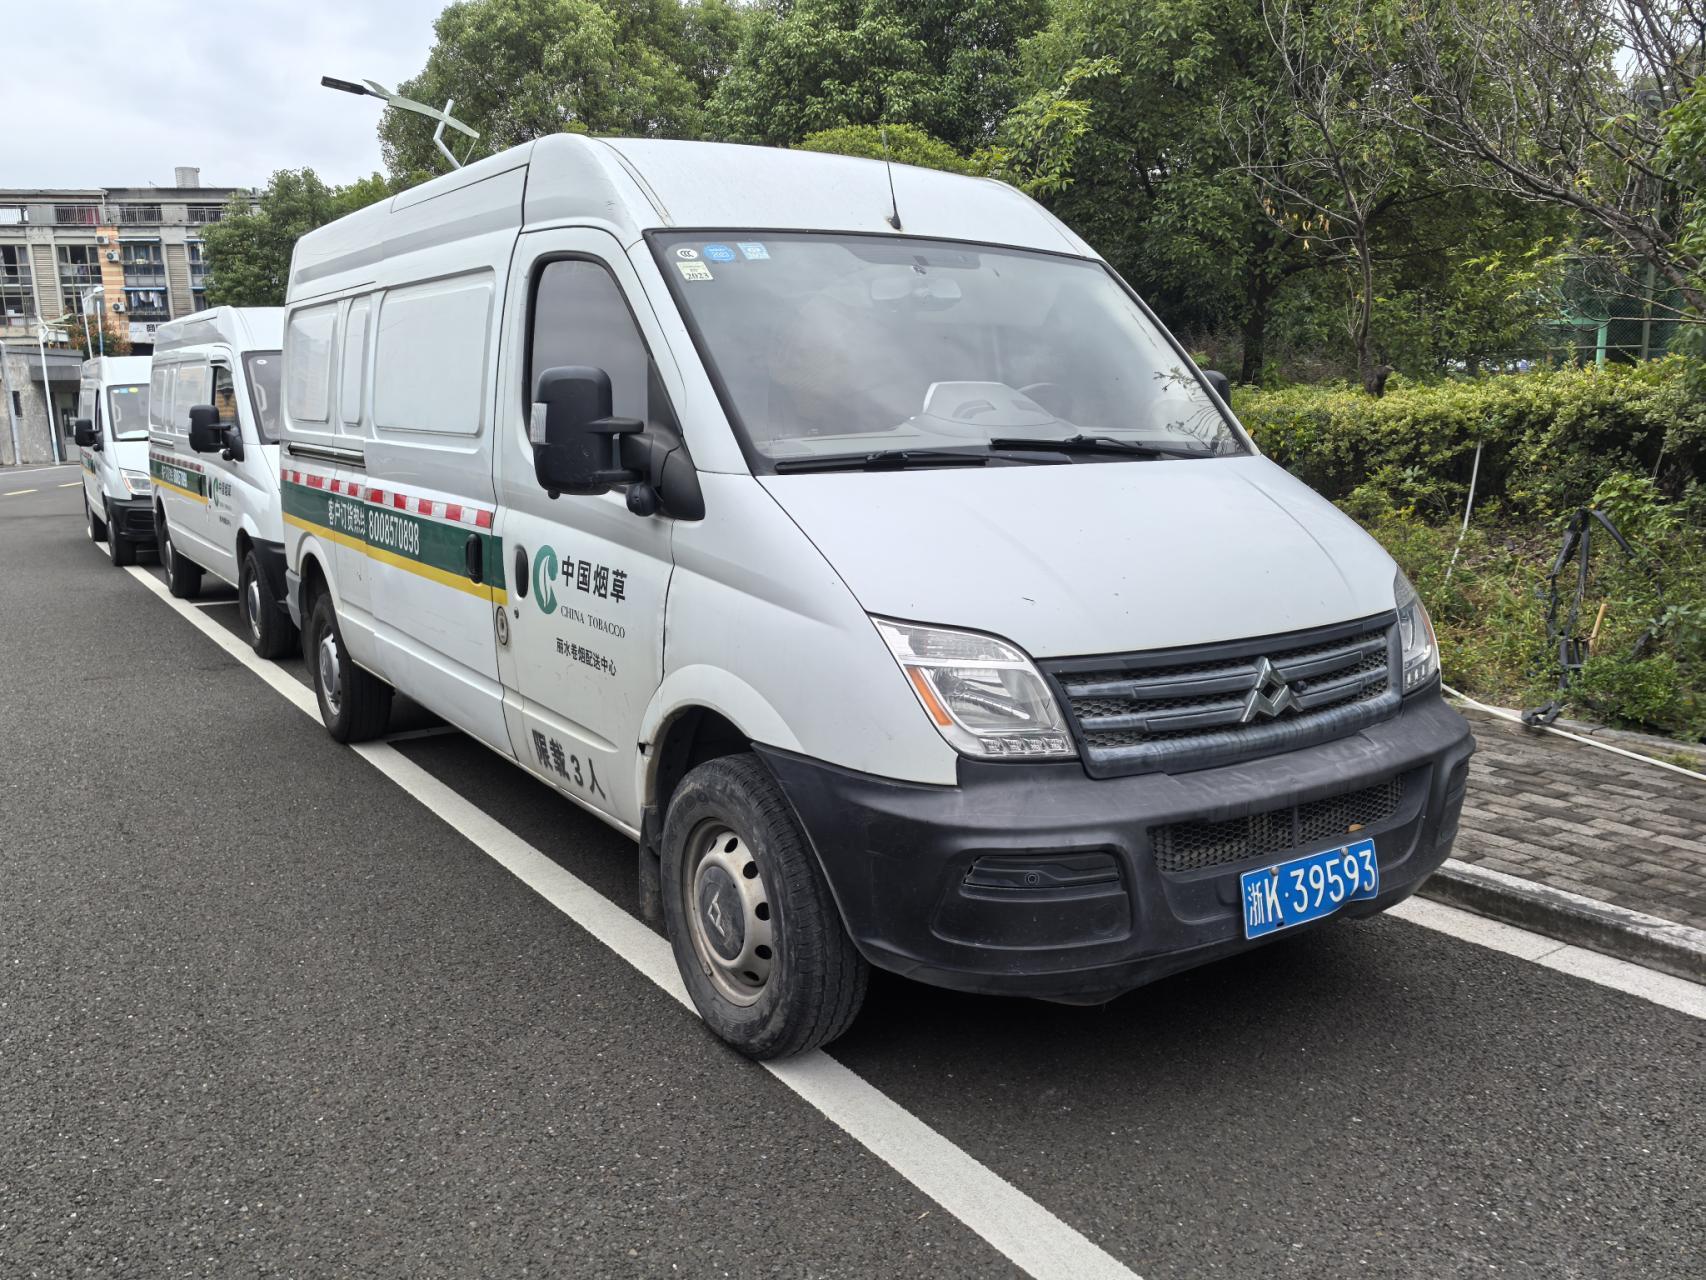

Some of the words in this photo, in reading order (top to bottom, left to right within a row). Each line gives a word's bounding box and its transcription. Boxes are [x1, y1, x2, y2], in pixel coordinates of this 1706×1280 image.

[368, 510, 420, 556] 8008570898
[561, 555, 628, 604] 中国烟草
[560, 605, 585, 624] CHINA
[587, 614, 626, 639] TOBACCO
[556, 637, 617, 677] 丽水卷烟配送中心
